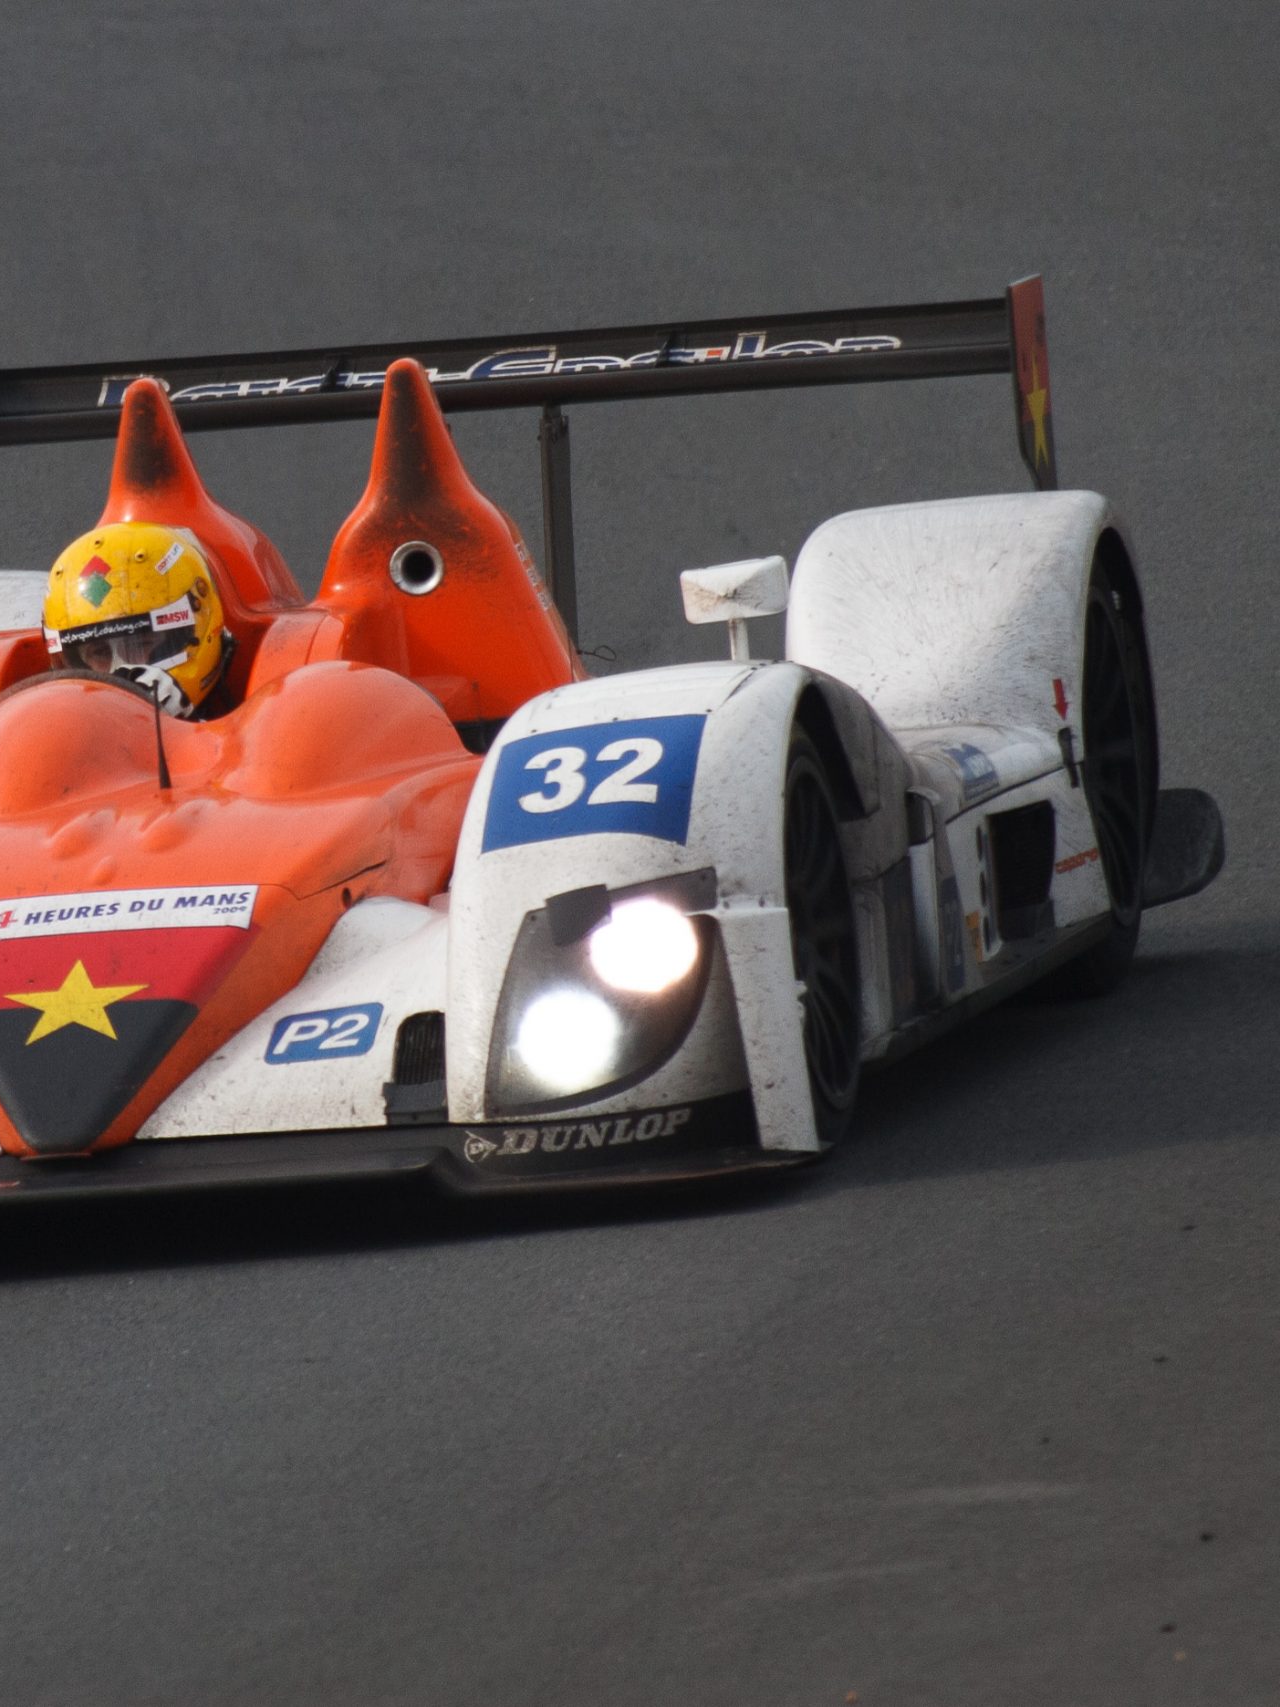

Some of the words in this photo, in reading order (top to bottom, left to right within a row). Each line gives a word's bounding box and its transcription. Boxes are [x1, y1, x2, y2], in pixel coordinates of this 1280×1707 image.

[163, 609, 190, 625] MSW
[518, 737, 665, 815] 32
[24, 901, 119, 926] HEURES
[128, 898, 163, 913] DU
[173, 891, 251, 909] MANS
[271, 1012, 371, 1056] P2
[496, 1108, 691, 1156] DUNLOP
